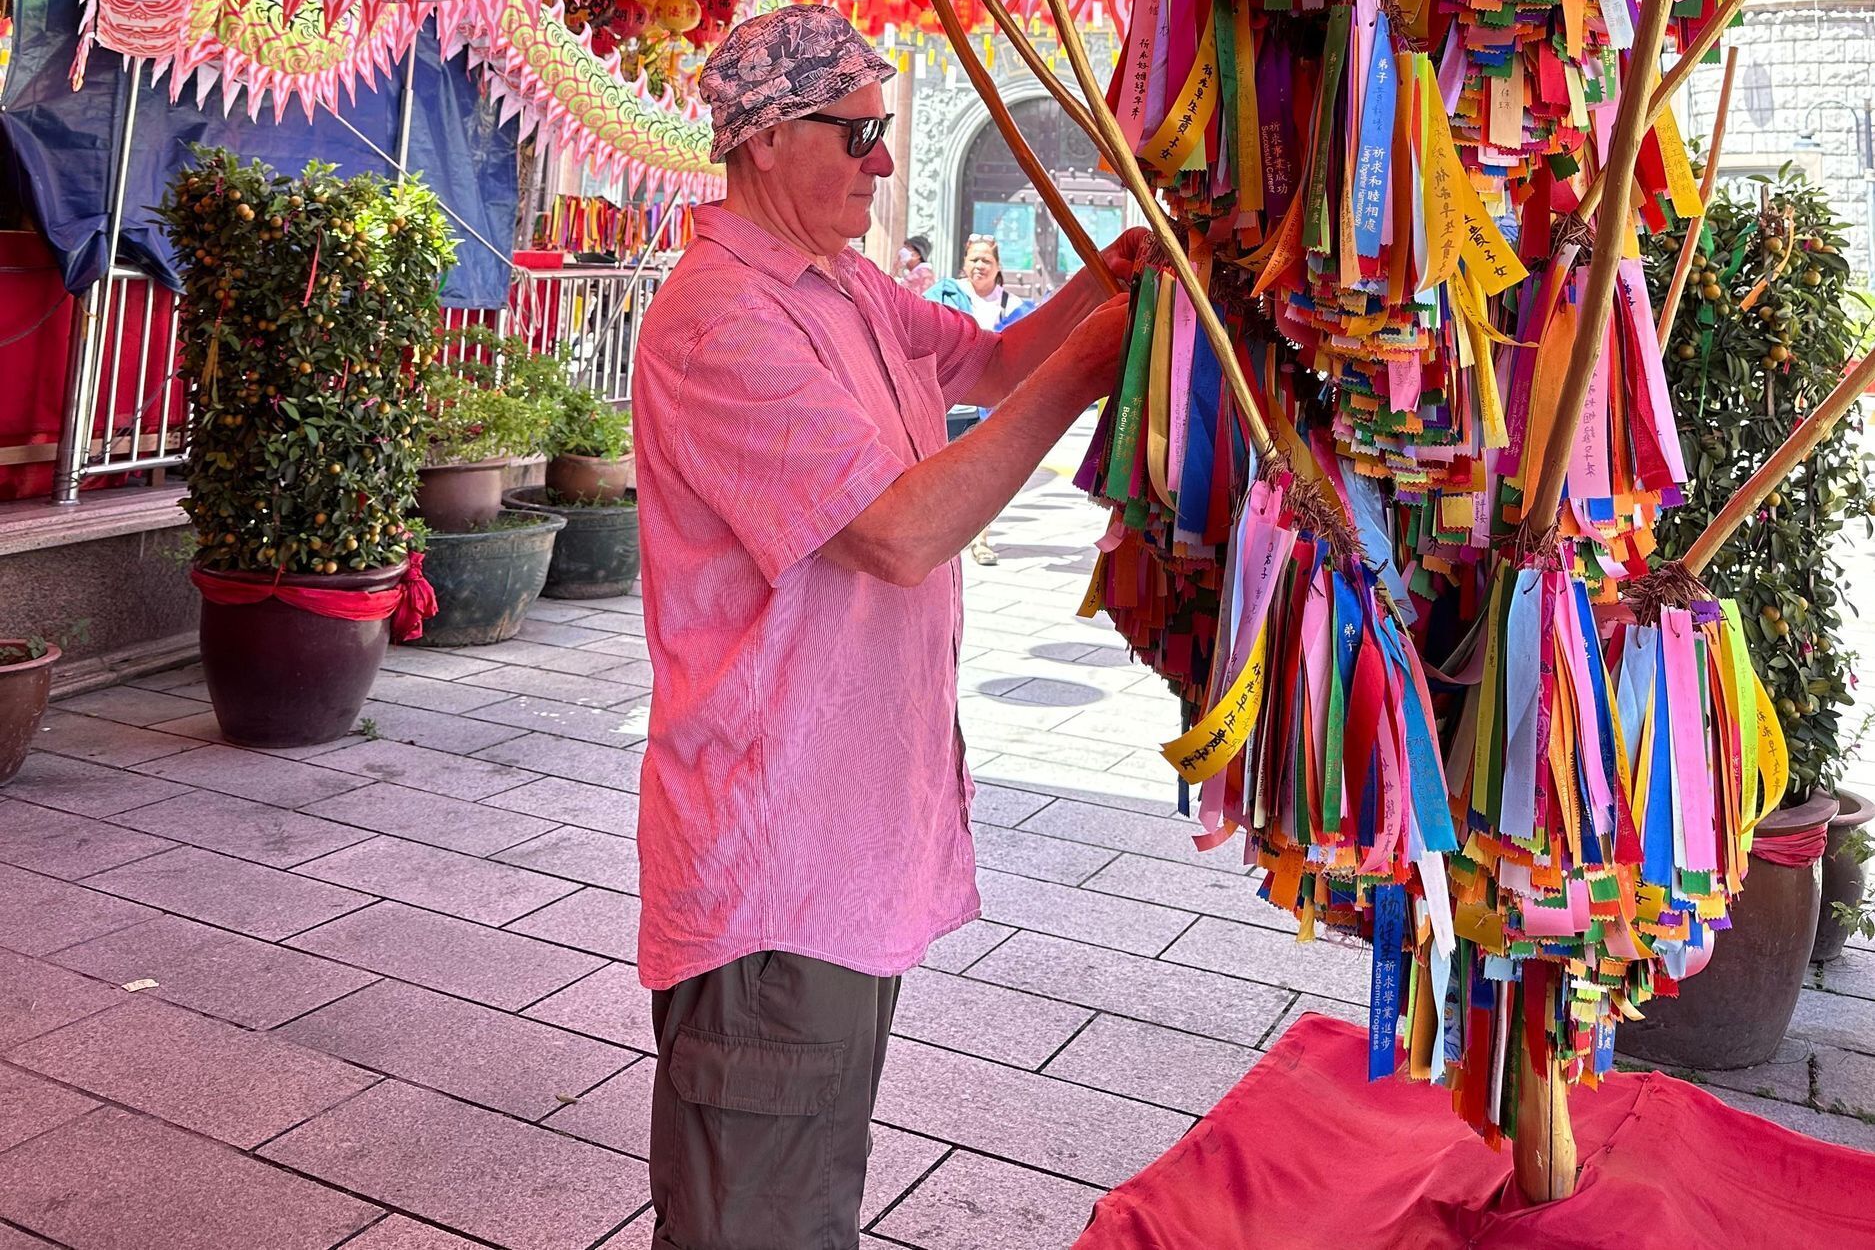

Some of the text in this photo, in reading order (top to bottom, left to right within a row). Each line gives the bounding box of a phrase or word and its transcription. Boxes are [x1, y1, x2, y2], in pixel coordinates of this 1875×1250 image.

[1376, 57, 1390, 84] 弟子
[1361, 145, 1387, 234] 祈求和睦相處
[1371, 961, 1383, 1051] Academic Progress
[1380, 959, 1397, 1051] 祈求學業進步
